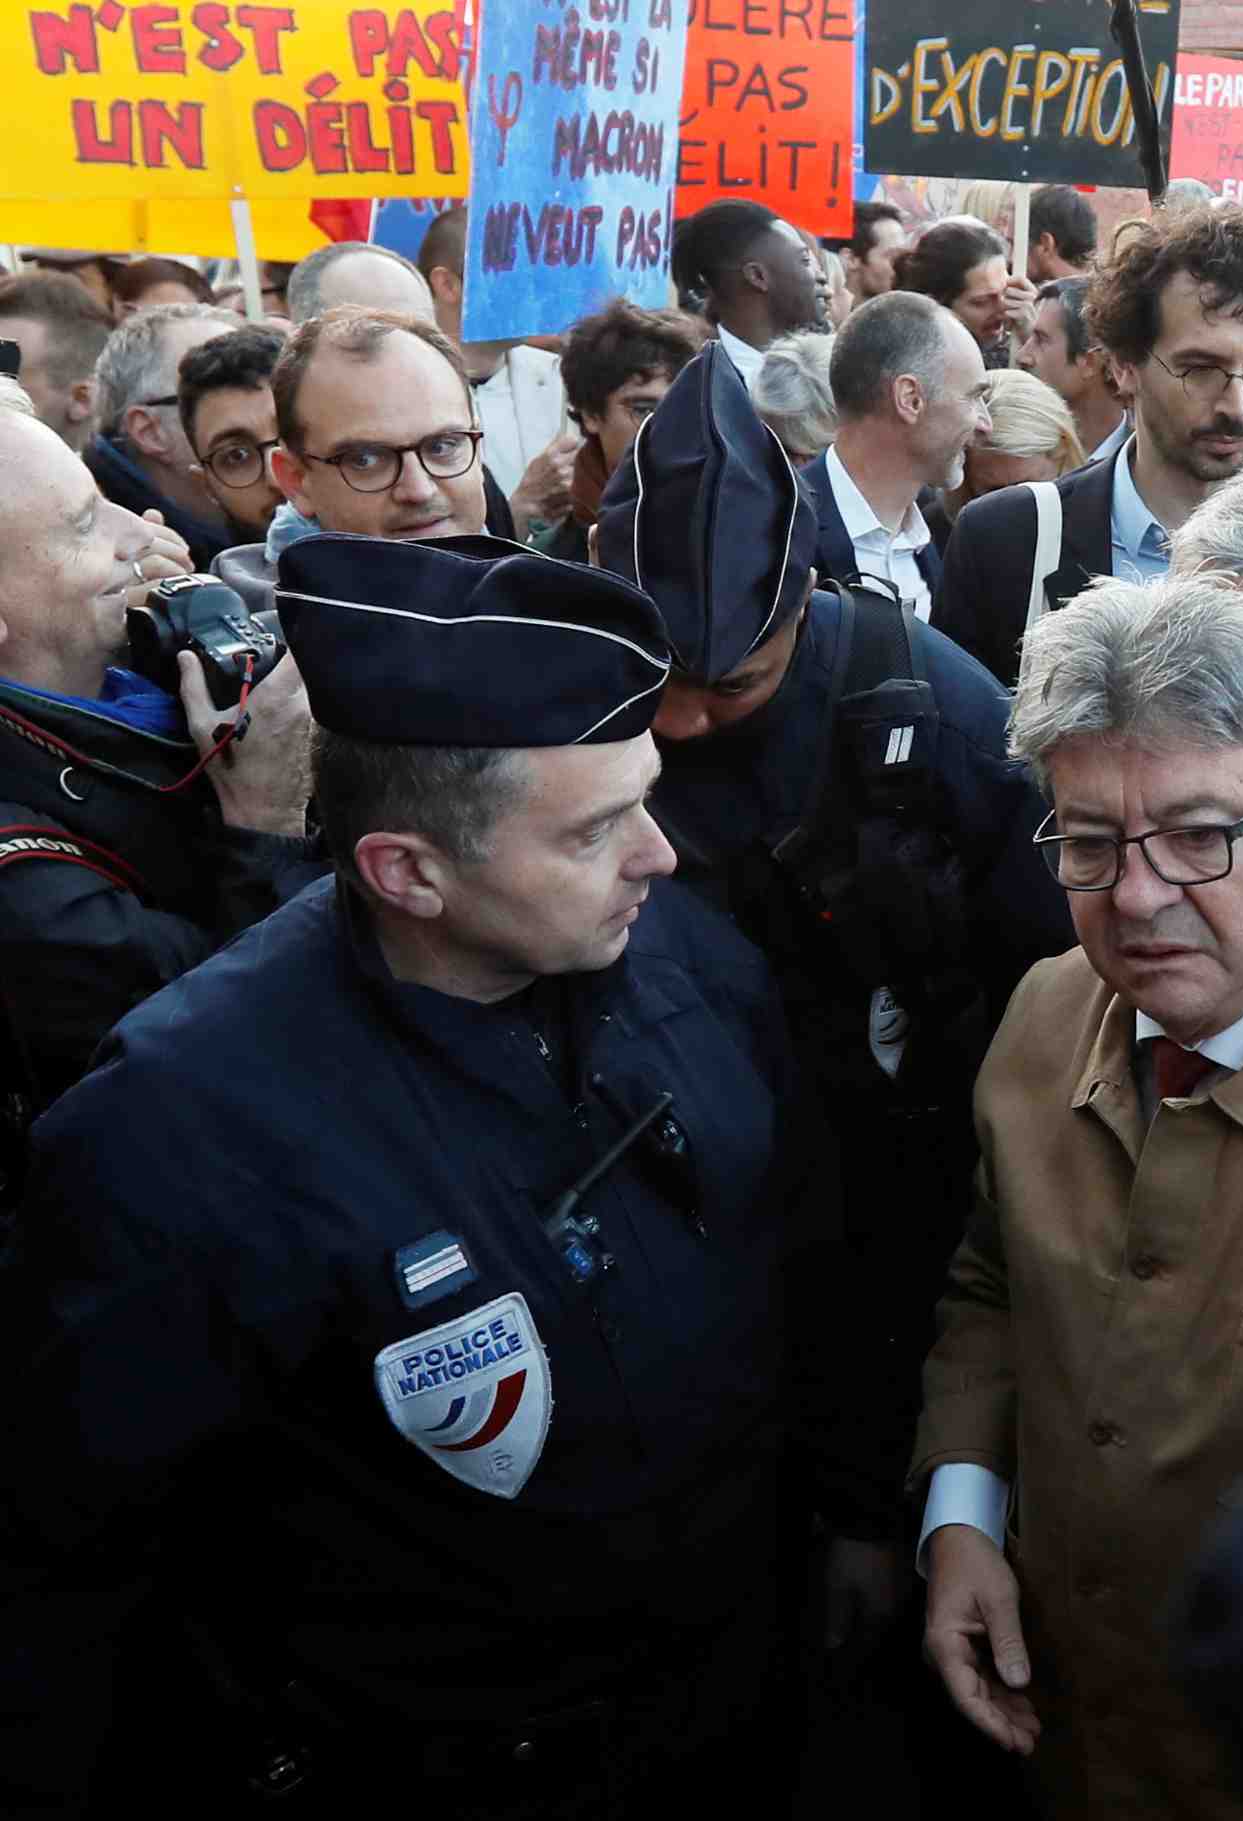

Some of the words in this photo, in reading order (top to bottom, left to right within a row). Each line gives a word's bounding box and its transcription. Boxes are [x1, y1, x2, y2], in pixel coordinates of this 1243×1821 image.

[29, 2, 298, 76] N'EST
[349, 10, 460, 81] PAS
[533, 7, 621, 91] MÊME
[632, 37, 660, 95] SI
[688, 0, 854, 42] LERE
[706, 60, 810, 113] PAS
[1174, 73, 1202, 106] LE
[71, 98, 206, 169] UN
[550, 110, 665, 186] MACRON
[522, 203, 604, 267] VEUT
[0, 838, 83, 857] anon
[398, 1332, 524, 1396] NATIONALE
[402, 1319, 507, 1375] POLICE
